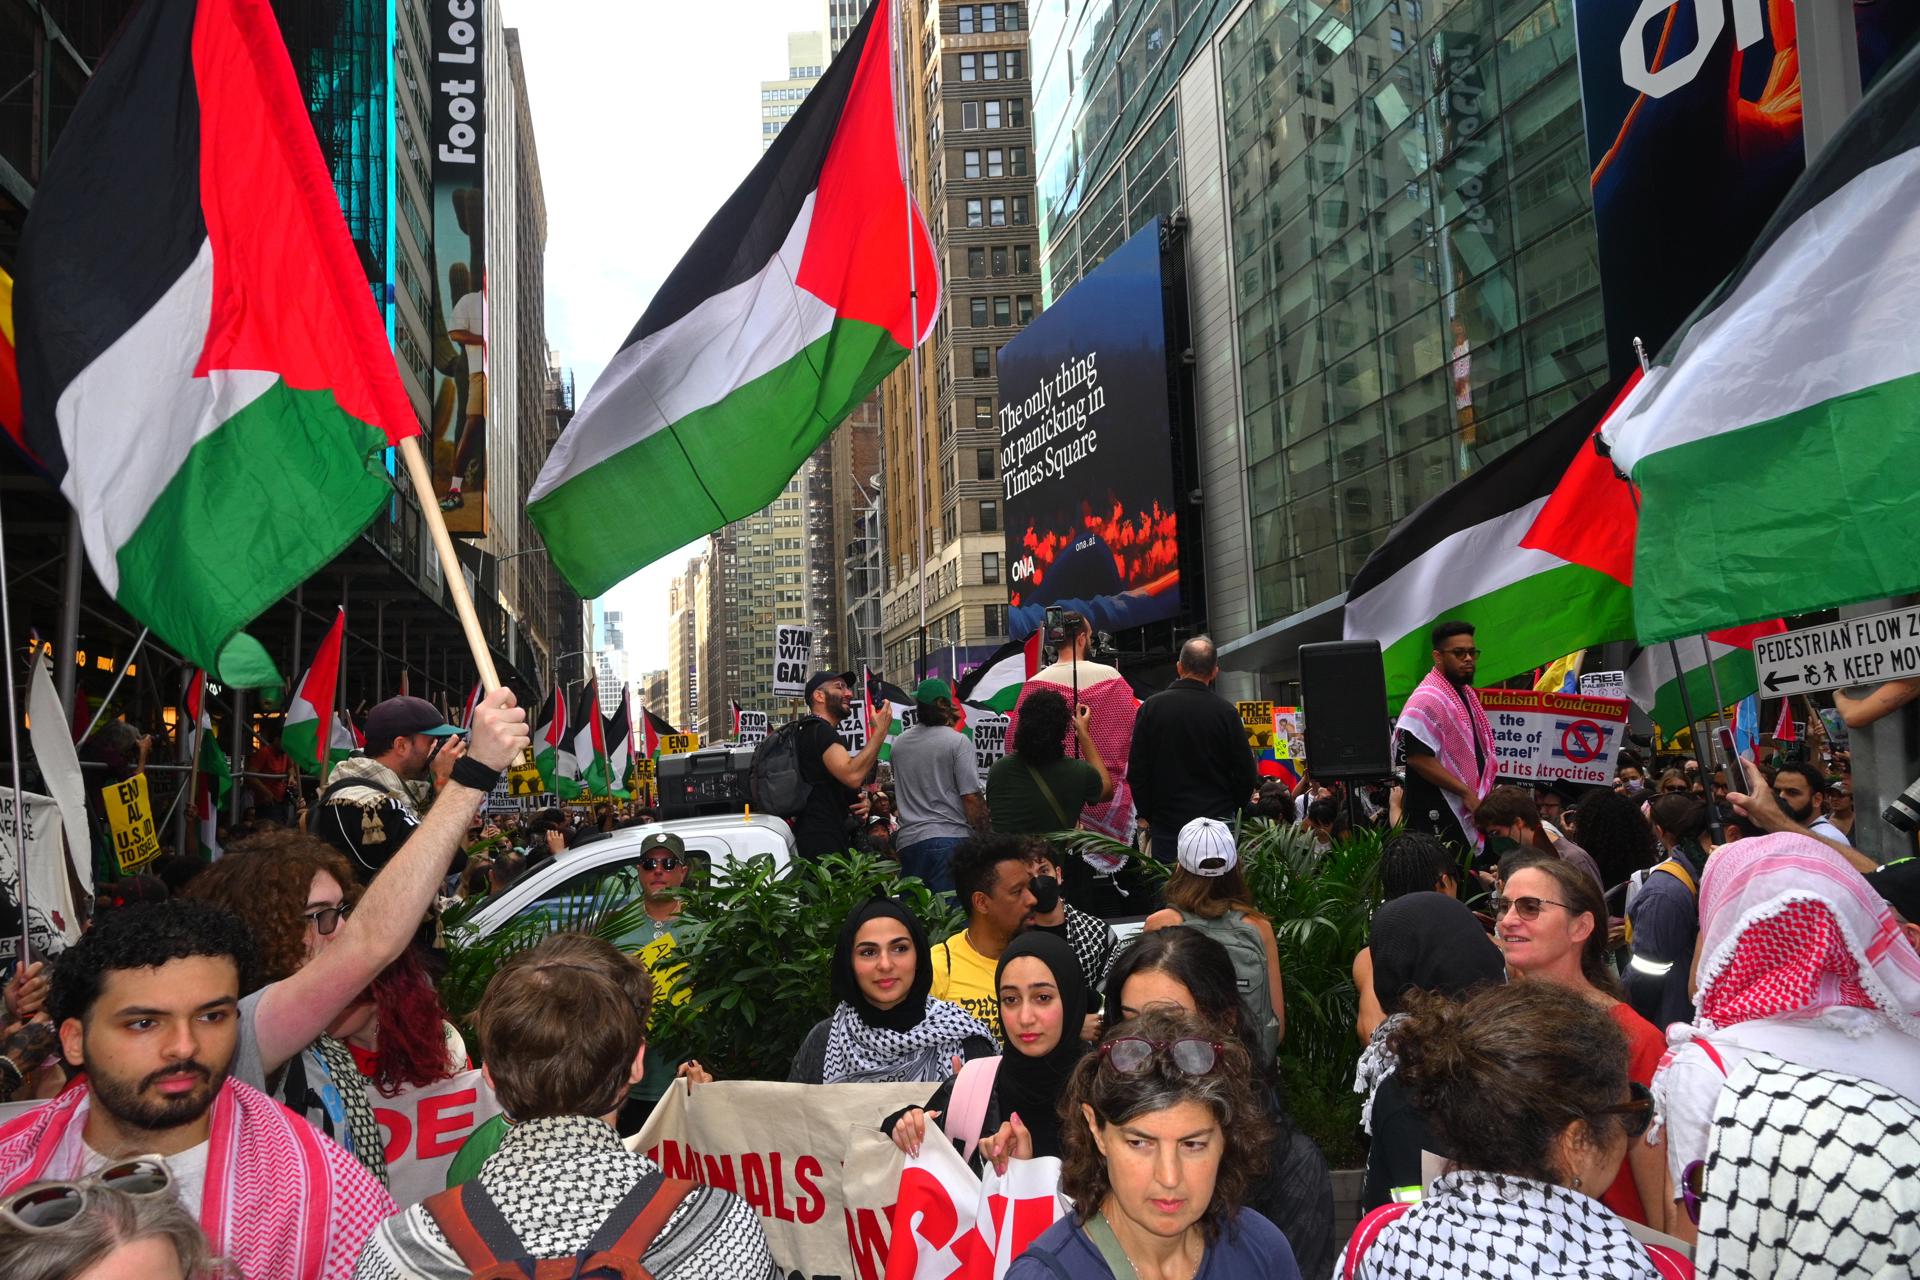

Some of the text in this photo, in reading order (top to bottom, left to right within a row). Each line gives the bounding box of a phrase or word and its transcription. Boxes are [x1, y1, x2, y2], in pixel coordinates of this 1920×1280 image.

[999, 351, 1098, 438] The only thing
[1017, 401, 1087, 463] panicking
[1088, 386, 1106, 417] in
[1003, 429, 1098, 500] Times Square
[1075, 533, 1096, 552] ona.ai
[1012, 556, 1036, 582] ONA
[780, 629, 812, 647] STAN
[1758, 626, 1852, 664] PEDESTRIAN
[1856, 616, 1901, 646] FLOW
[779, 646, 810, 660] WIT
[1844, 652, 1884, 680] KEEP
[1582, 672, 1622, 684] FREE
[1240, 702, 1270, 718] FREE
[1479, 691, 1623, 716] Judaism Condemns
[740, 713, 766, 726] STOP
[836, 720, 864, 732] AZA
[1500, 714, 1525, 726] the
[975, 725, 1006, 738] STAN
[1492, 728, 1542, 744] tate of
[668, 736, 689, 748] END
[975, 738, 1004, 750] WIT
[1495, 746, 1540, 759] srael”
[1514, 761, 1532, 776] its
[1536, 763, 1606, 782] Atrocities
[116, 826, 145, 849] U.S.
[119, 848, 136, 864] TO
